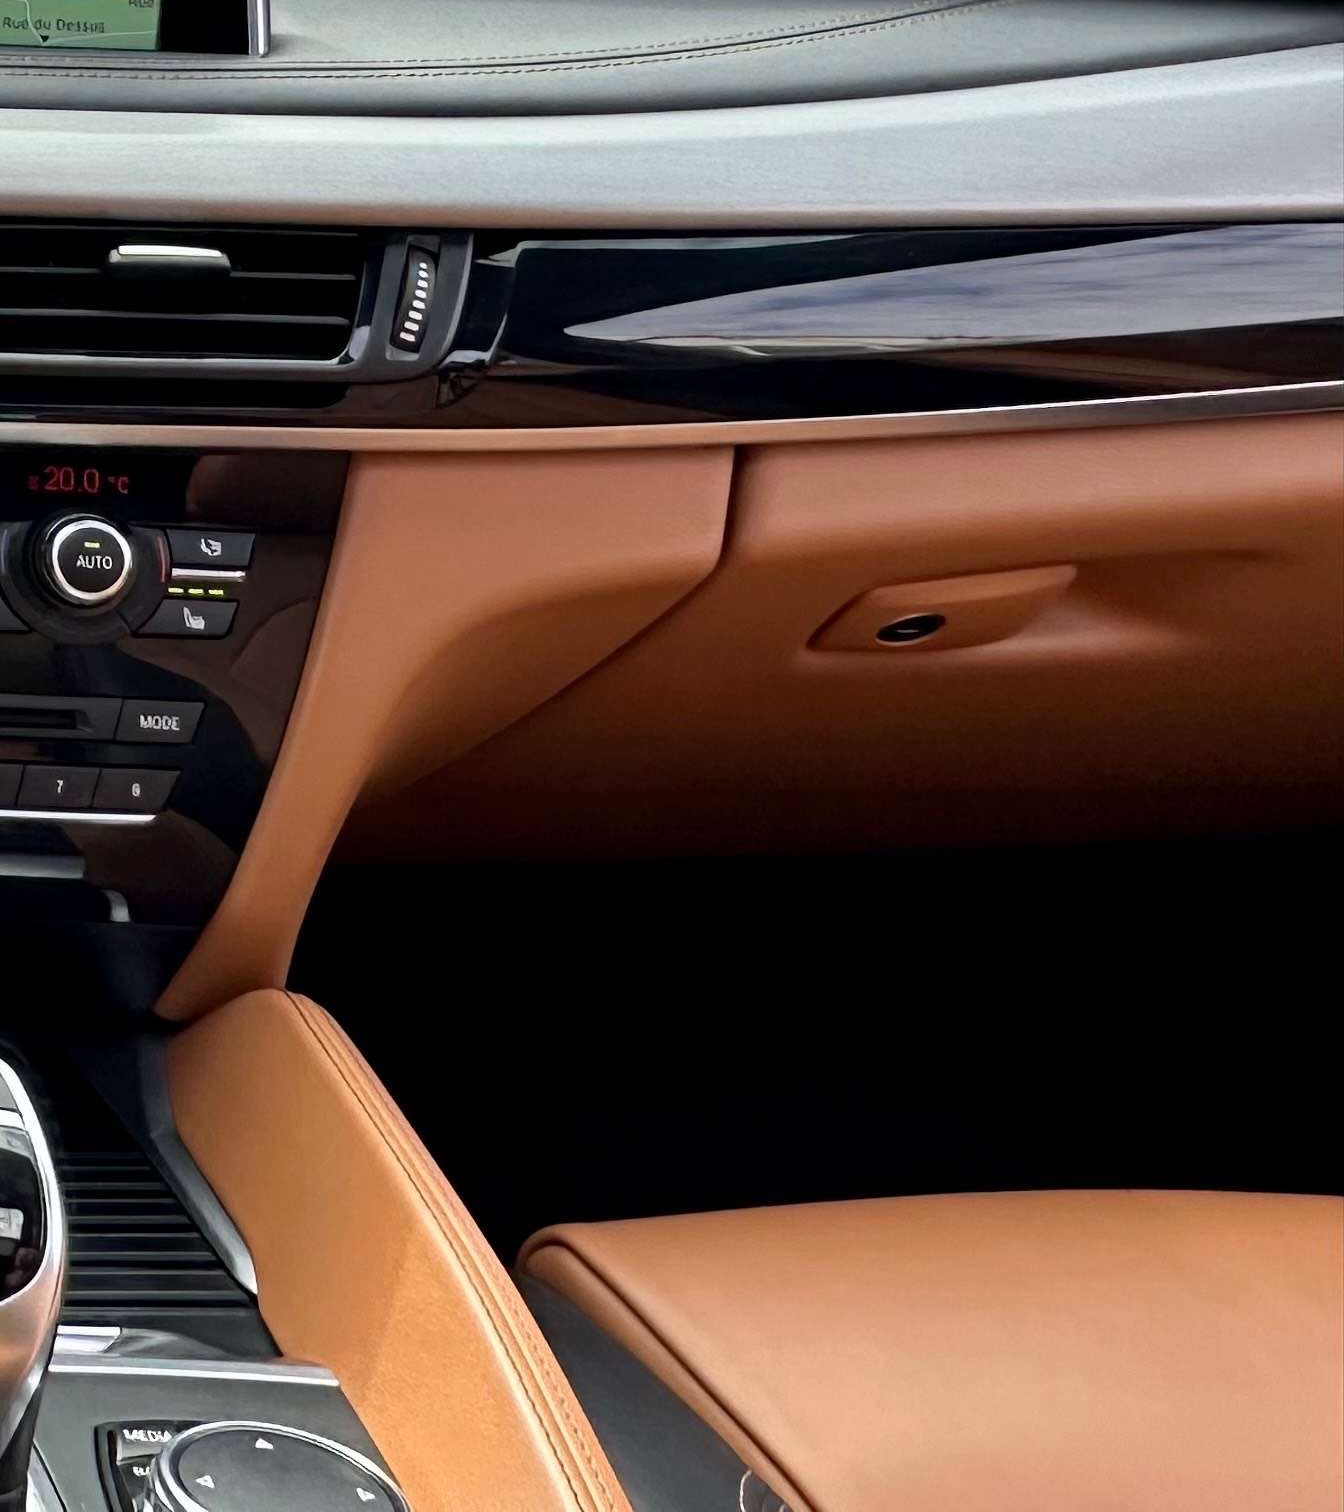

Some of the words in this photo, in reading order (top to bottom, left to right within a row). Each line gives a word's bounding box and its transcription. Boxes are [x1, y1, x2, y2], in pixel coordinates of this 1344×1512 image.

[2, 16, 29, 31] Rue
[42, 464, 100, 494] 20.0
[75, 553, 114, 571] AUTO
[138, 713, 181, 731] MODE
